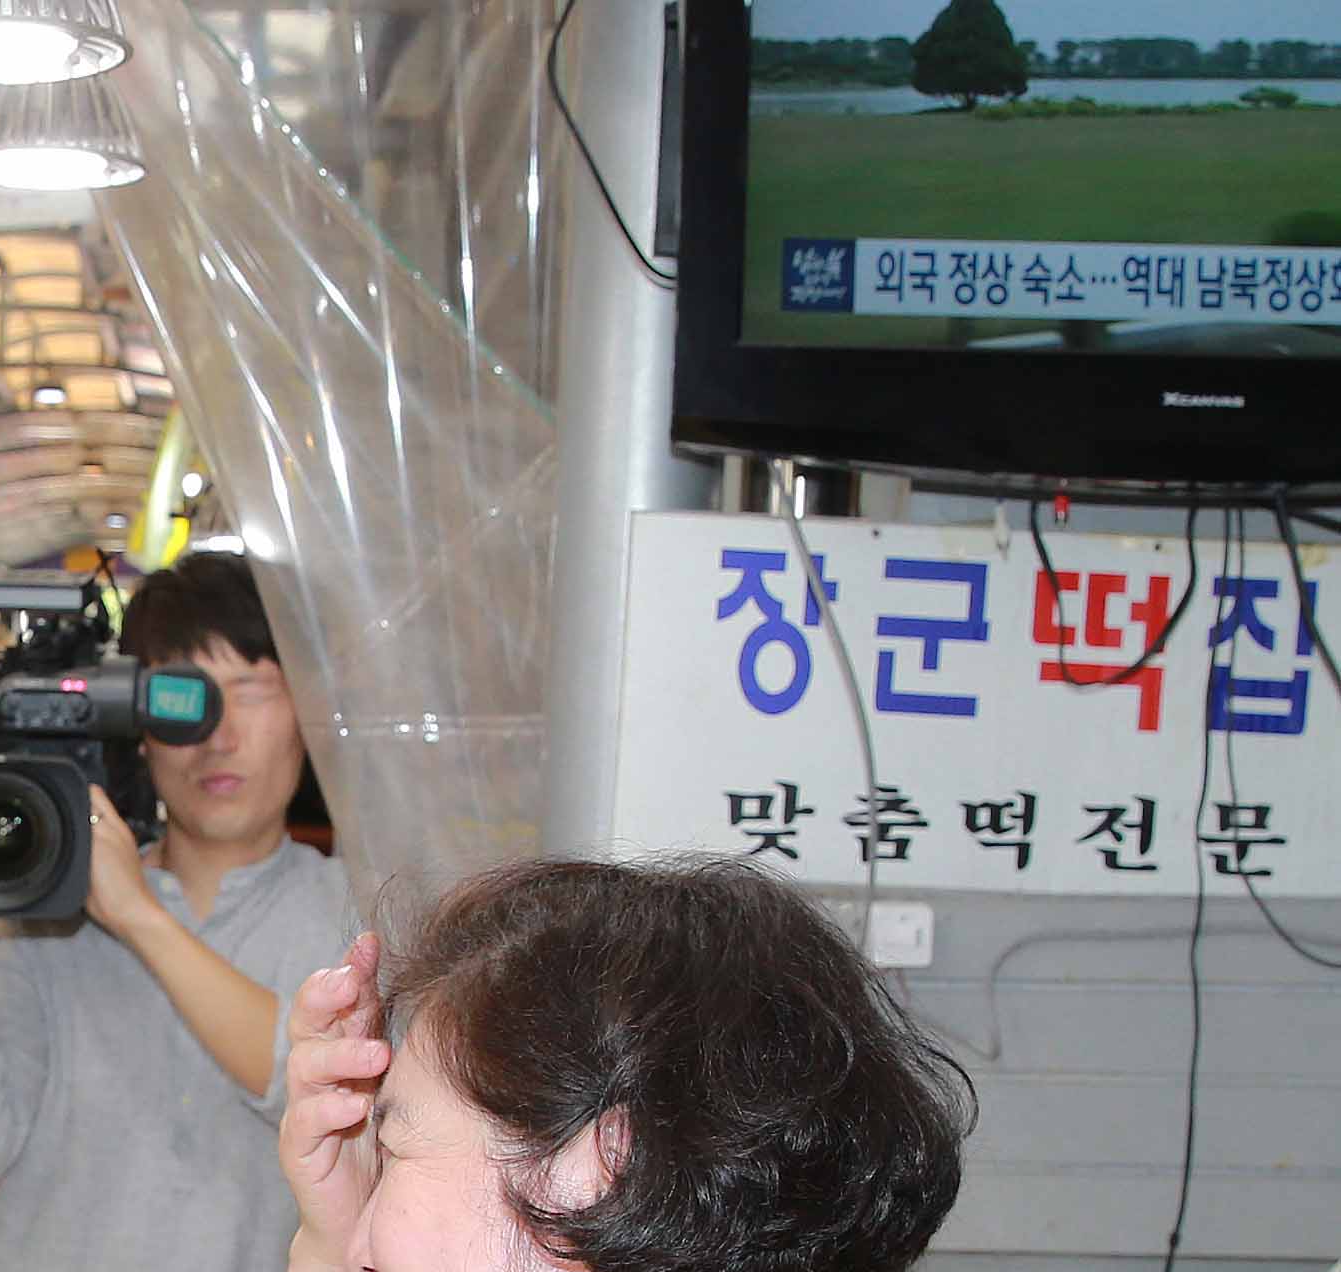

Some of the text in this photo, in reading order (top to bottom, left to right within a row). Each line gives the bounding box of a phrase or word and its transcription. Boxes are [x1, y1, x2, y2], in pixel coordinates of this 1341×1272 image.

[875, 251, 938, 303] 외국
[948, 252, 1013, 306] 정상
[716, 547, 1318, 736] 장군떡집
